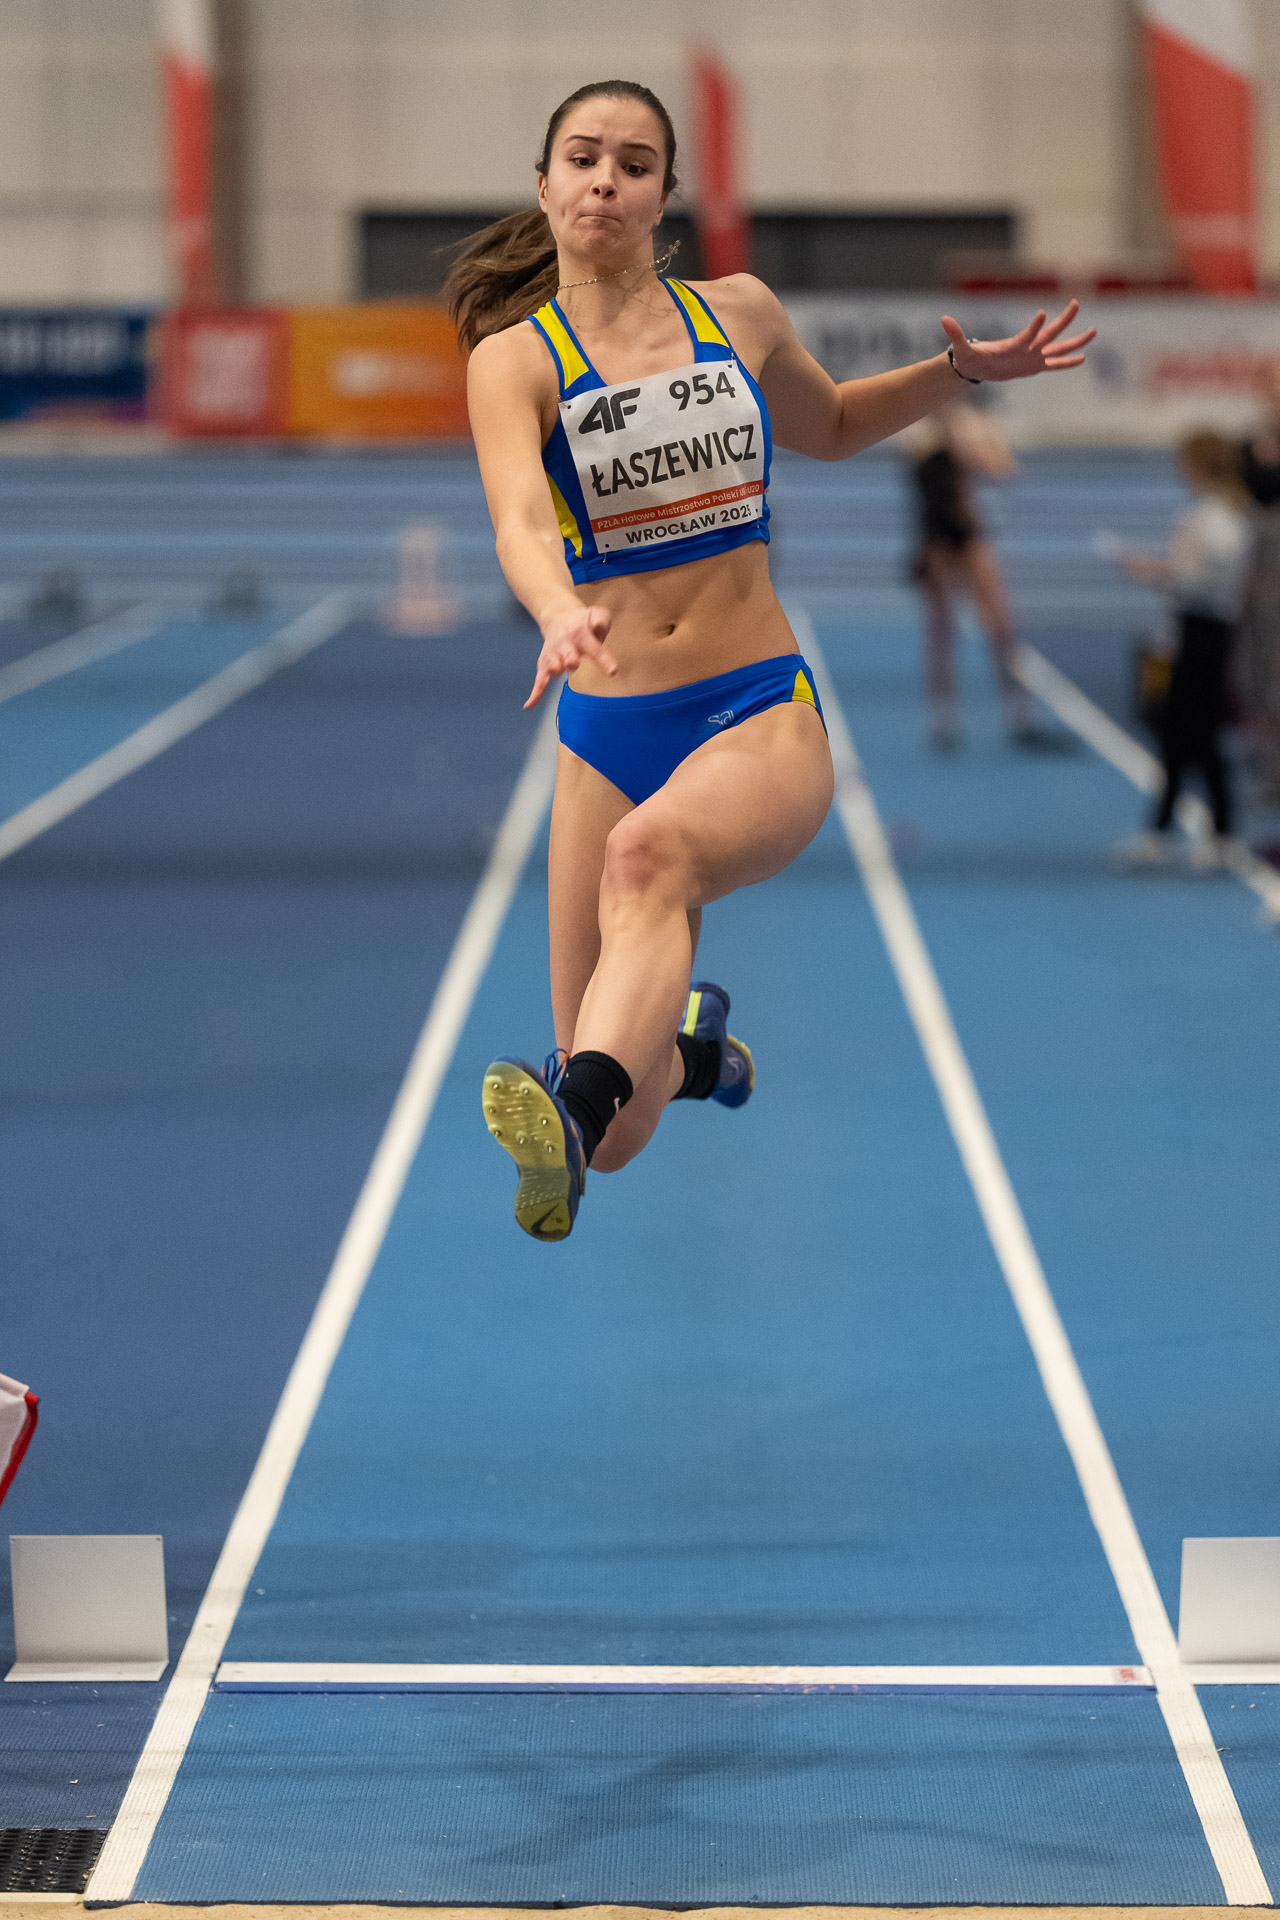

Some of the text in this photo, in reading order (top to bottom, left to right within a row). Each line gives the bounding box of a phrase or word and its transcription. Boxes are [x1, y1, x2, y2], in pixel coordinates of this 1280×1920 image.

[578, 387, 641, 435] 4F
[668, 371, 736, 411] 954
[590, 424, 757, 498] ŁASZEWICZ
[597, 518, 620, 529] PZLA
[620, 511, 656, 524] Halowe
[657, 497, 711, 517] Mistrzostwa
[712, 489, 739, 503] Polski
[625, 512, 716, 544] WROCŁAW
